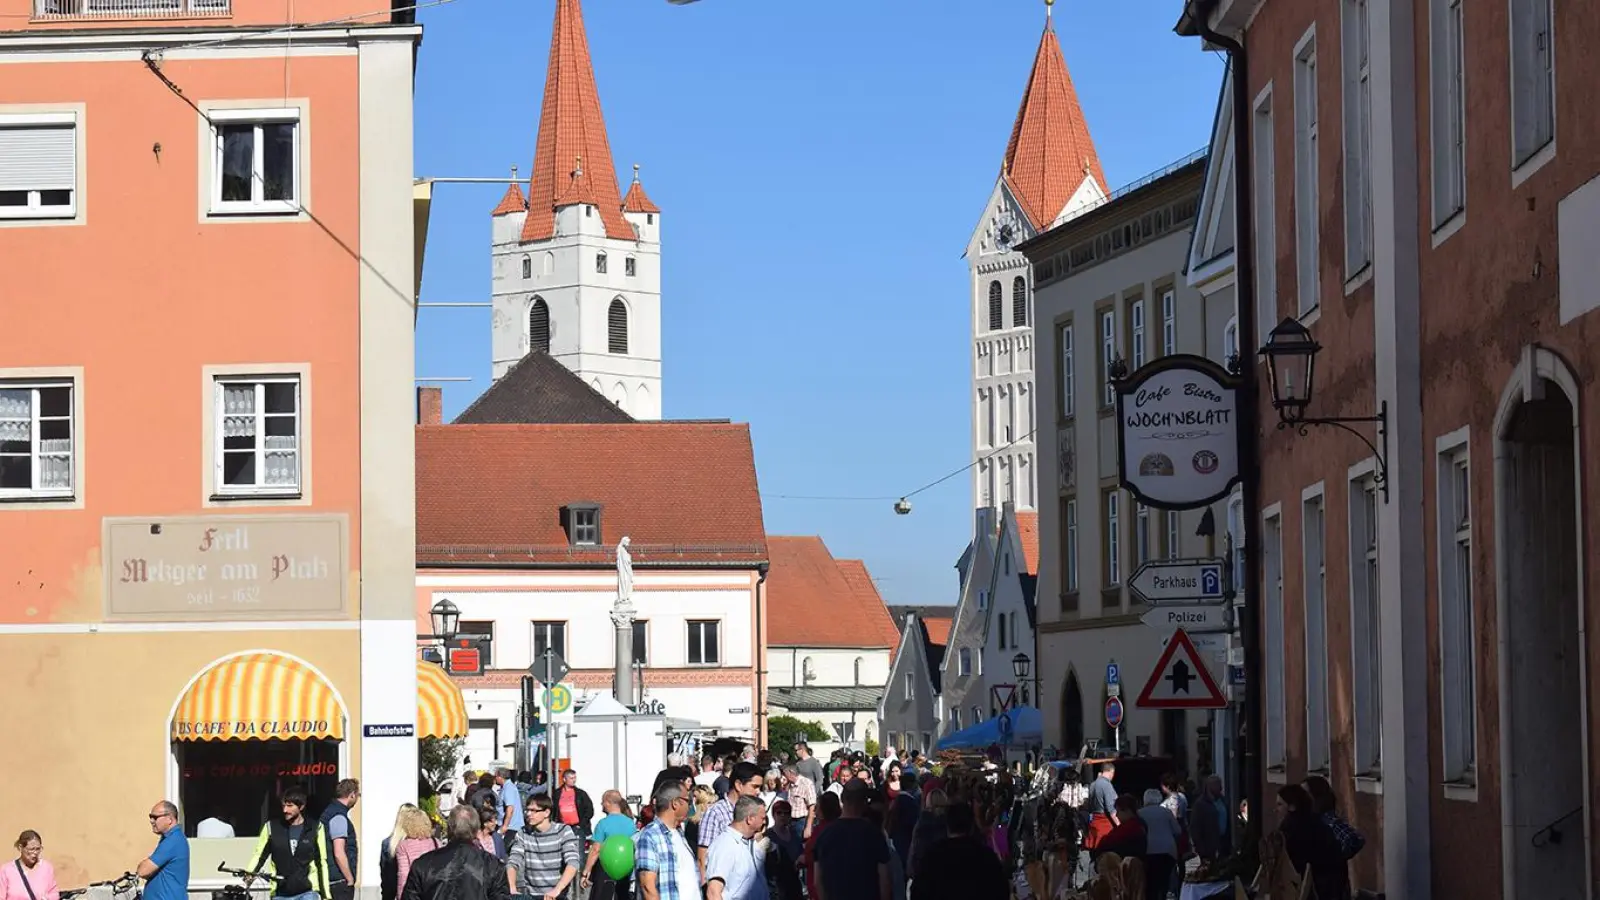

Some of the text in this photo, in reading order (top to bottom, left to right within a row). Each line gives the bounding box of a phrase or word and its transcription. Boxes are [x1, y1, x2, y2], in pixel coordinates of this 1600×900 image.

[1135, 382, 1222, 408] Cafe Bistro
[1127, 409, 1231, 428] WOCH'NBLATT
[220, 564, 258, 581] am
[1153, 576, 1197, 589] Parkhaus
[1168, 612, 1206, 624] Polizei
[234, 721, 255, 734] DA
[260, 720, 328, 733] CLAUDIO
